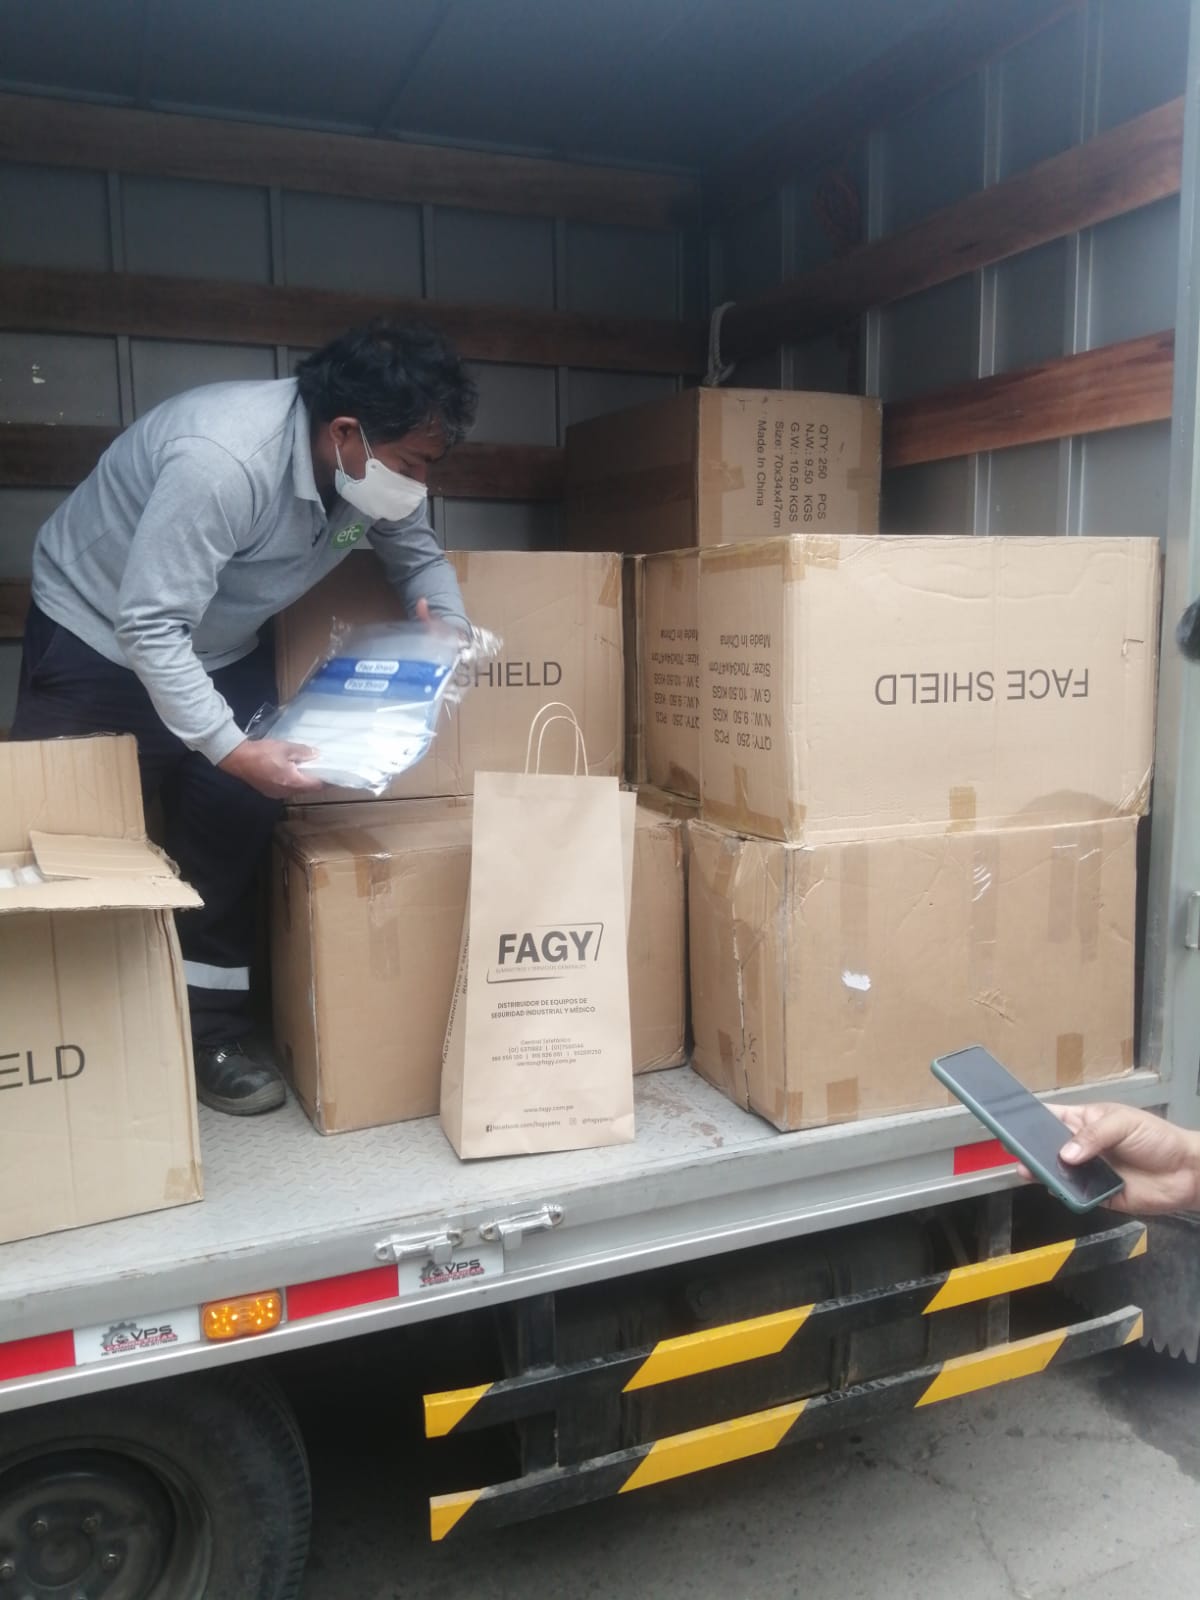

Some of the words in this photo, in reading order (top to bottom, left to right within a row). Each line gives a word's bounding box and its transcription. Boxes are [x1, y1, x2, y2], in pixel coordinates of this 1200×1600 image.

[757, 419, 767, 454] Made
[774, 421, 784, 450] Size:
[757, 457, 766, 469] In
[804, 458, 814, 484] 9.50
[818, 458, 827, 480] 250
[789, 460, 799, 492] 10.50
[756, 472, 766, 506] China
[773, 454, 784, 528] 70x34x47cm
[788, 495, 798, 522] KGS
[803, 495, 813, 522] KGS
[817, 493, 827, 520] PCS
[684, 629, 699, 642] ade
[720, 634, 740, 648] China
[740, 634, 748, 648] In
[750, 634, 771, 648] Made
[687, 654, 700, 666] ize:
[453, 662, 562, 688] SHIELD
[709, 661, 750, 676] 70x34x47cm
[752, 662, 771, 678] Size:
[712, 685, 728, 699] KGS
[874, 670, 995, 706] SHIELD
[1006, 668, 1088, 700] FACE
[728, 686, 748, 701] 10.50
[712, 708, 728, 722] KGS
[734, 710, 749, 725] 9.50
[714, 728, 730, 744] PCS
[736, 732, 750, 746] 250
[498, 930, 594, 965] FAGY
[498, 1000, 540, 1009] DISTRIBUIDOR
[550, 998, 578, 1006] EQUIPOS
[491, 1010, 526, 1019] SEGURIDAD
[526, 1008, 562, 1016] INDUSTRIAL
[570, 1006, 596, 1014] MÉDICO
[444, 1258, 481, 1274] VPS
[130, 1324, 172, 1340] VPS
